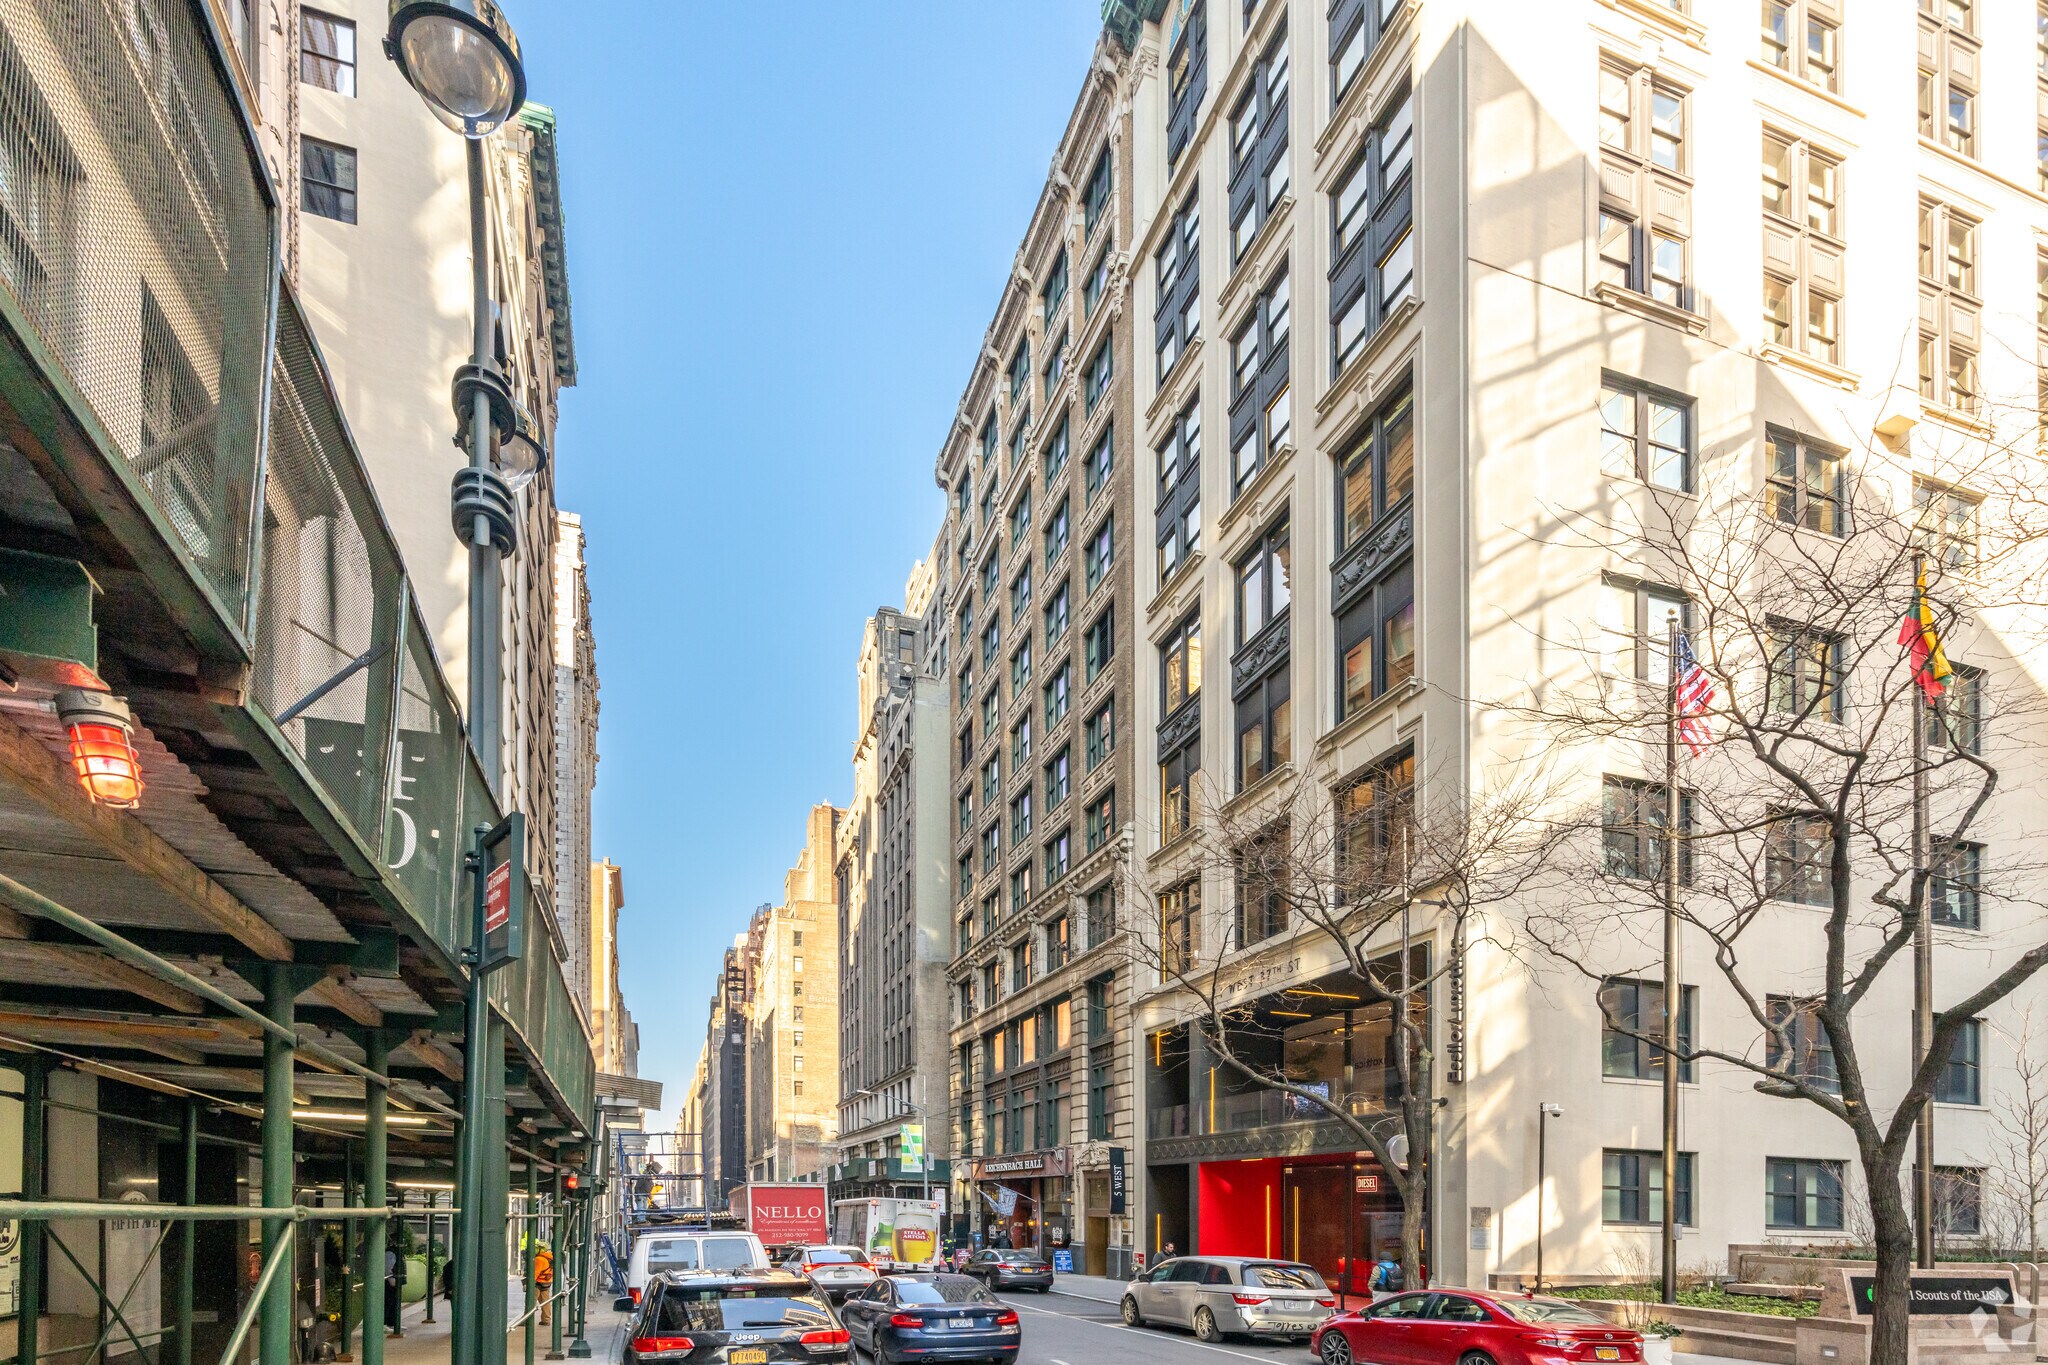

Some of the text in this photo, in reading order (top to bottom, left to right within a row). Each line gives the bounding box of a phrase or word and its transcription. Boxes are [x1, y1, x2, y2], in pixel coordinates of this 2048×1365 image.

[492, 868, 509, 888] STANDING
[1288, 957, 1301, 973] ST
[1024, 1159, 1043, 1170] HALL
[1113, 1165, 1123, 1190] WEST
[1357, 1178, 1376, 1188] DIESEL
[755, 1206, 822, 1219] NELLO
[1915, 1289, 1950, 1300] Scouts
[1951, 1289, 1962, 1300] of
[1963, 1289, 1980, 1300] the
[1980, 1290, 2004, 1300] USA
[735, 1333, 760, 1341] Jeep
